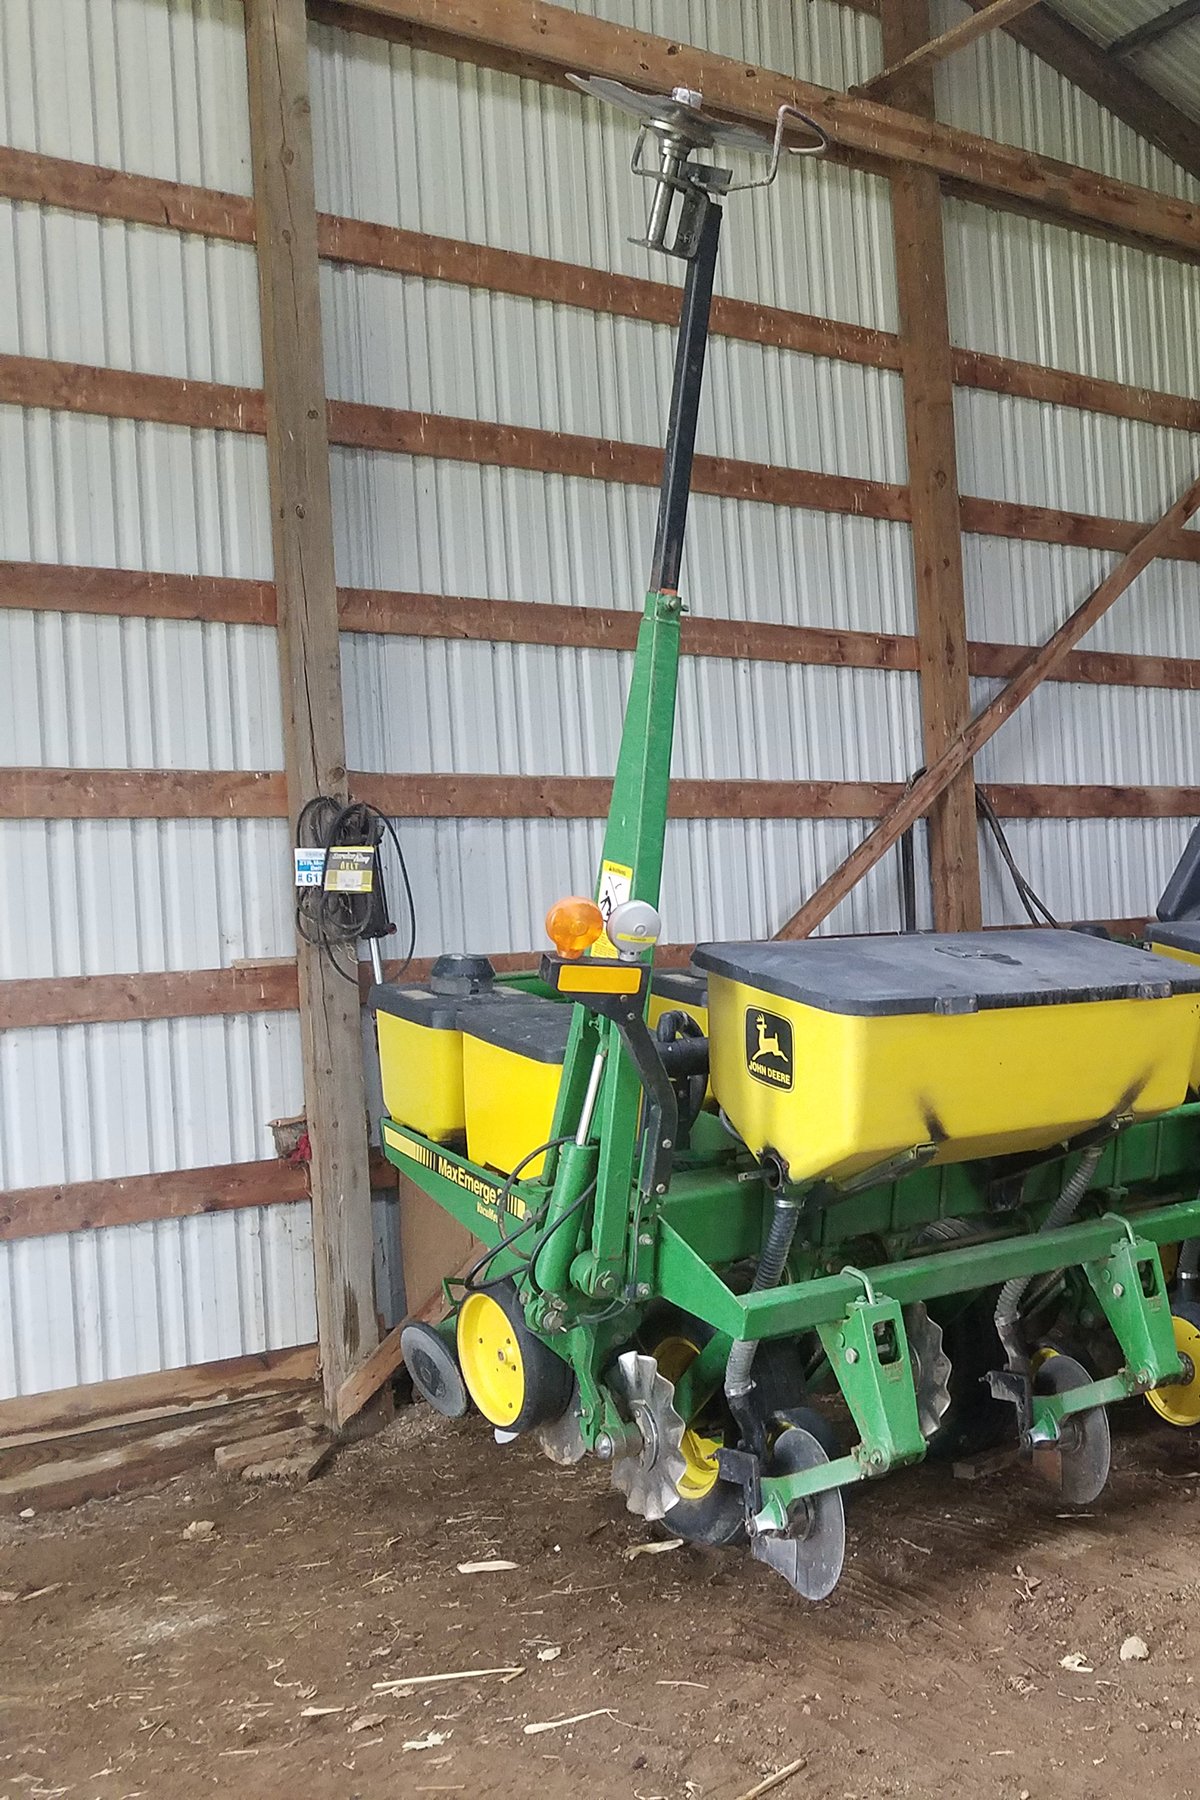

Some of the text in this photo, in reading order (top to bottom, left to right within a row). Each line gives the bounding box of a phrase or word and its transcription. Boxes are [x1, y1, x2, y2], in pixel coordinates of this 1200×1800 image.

[340, 861, 359, 870] BELT
[748, 1060, 791, 1085] JOHN DEERE
[438, 1156, 496, 1204] MaxEmerge
